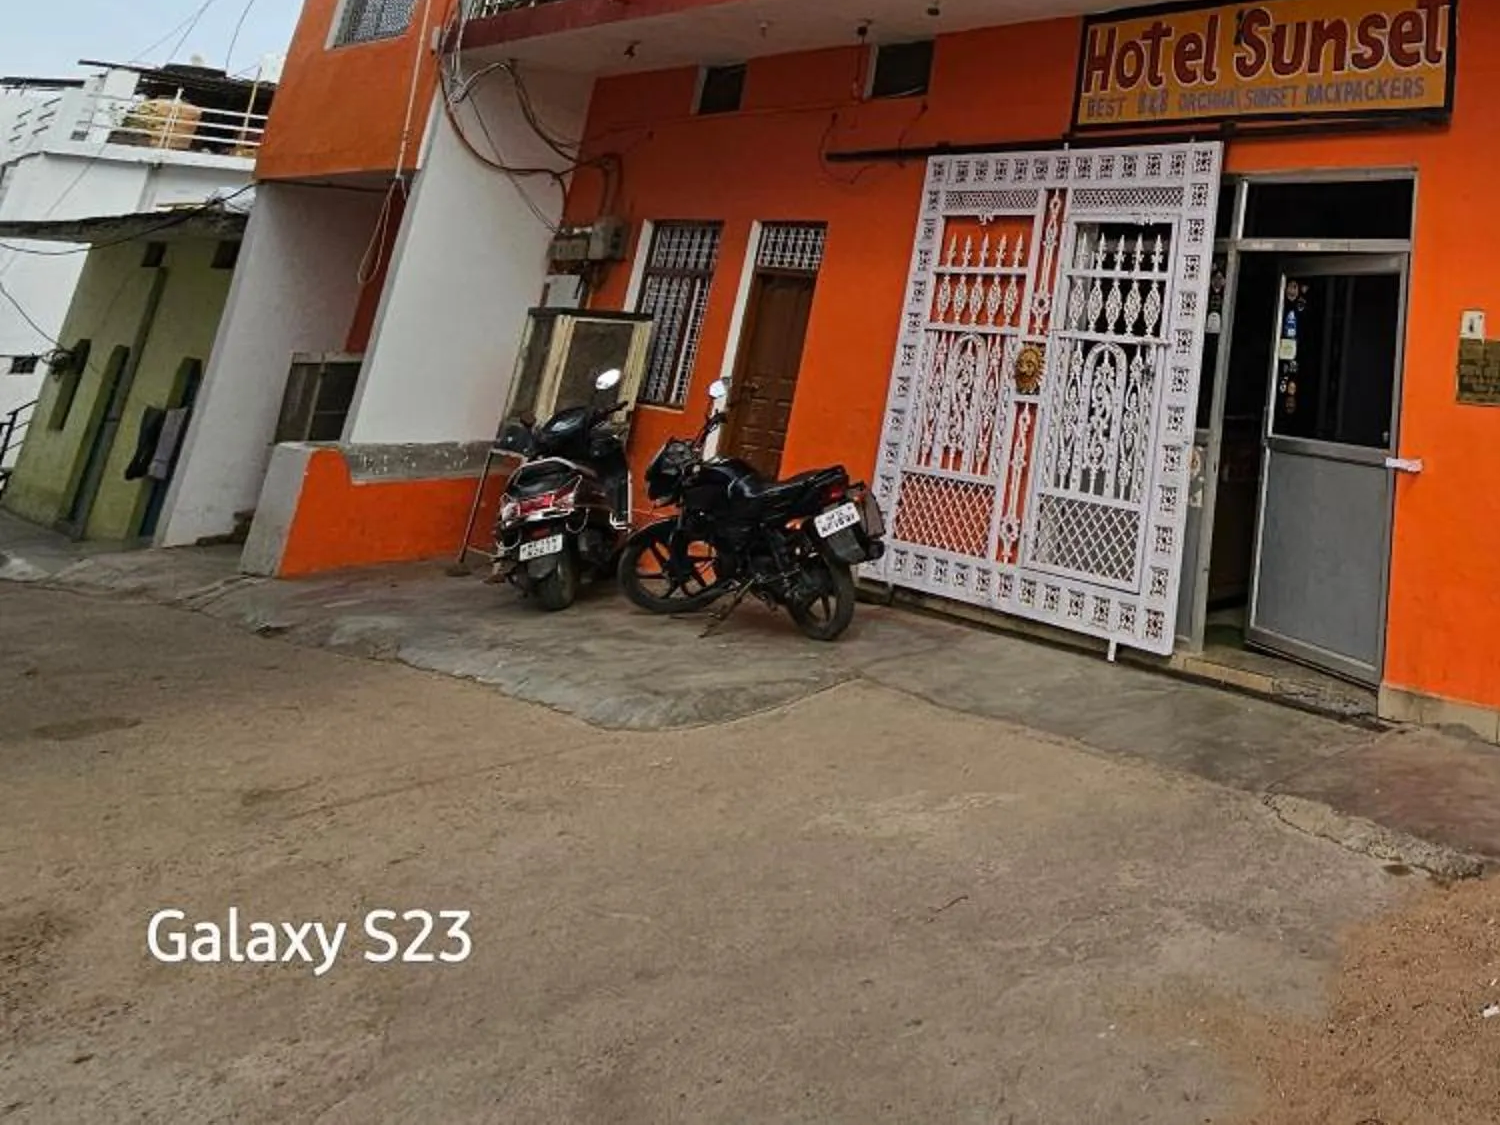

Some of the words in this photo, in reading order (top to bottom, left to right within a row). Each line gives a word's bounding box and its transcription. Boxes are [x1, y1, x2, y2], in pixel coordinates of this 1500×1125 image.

[1083, 13, 1222, 95] Hotel
[1087, 97, 1127, 118] BEST
[1245, 86, 1300, 109] SUNSET
[1306, 76, 1425, 105] BACKPACKERS
